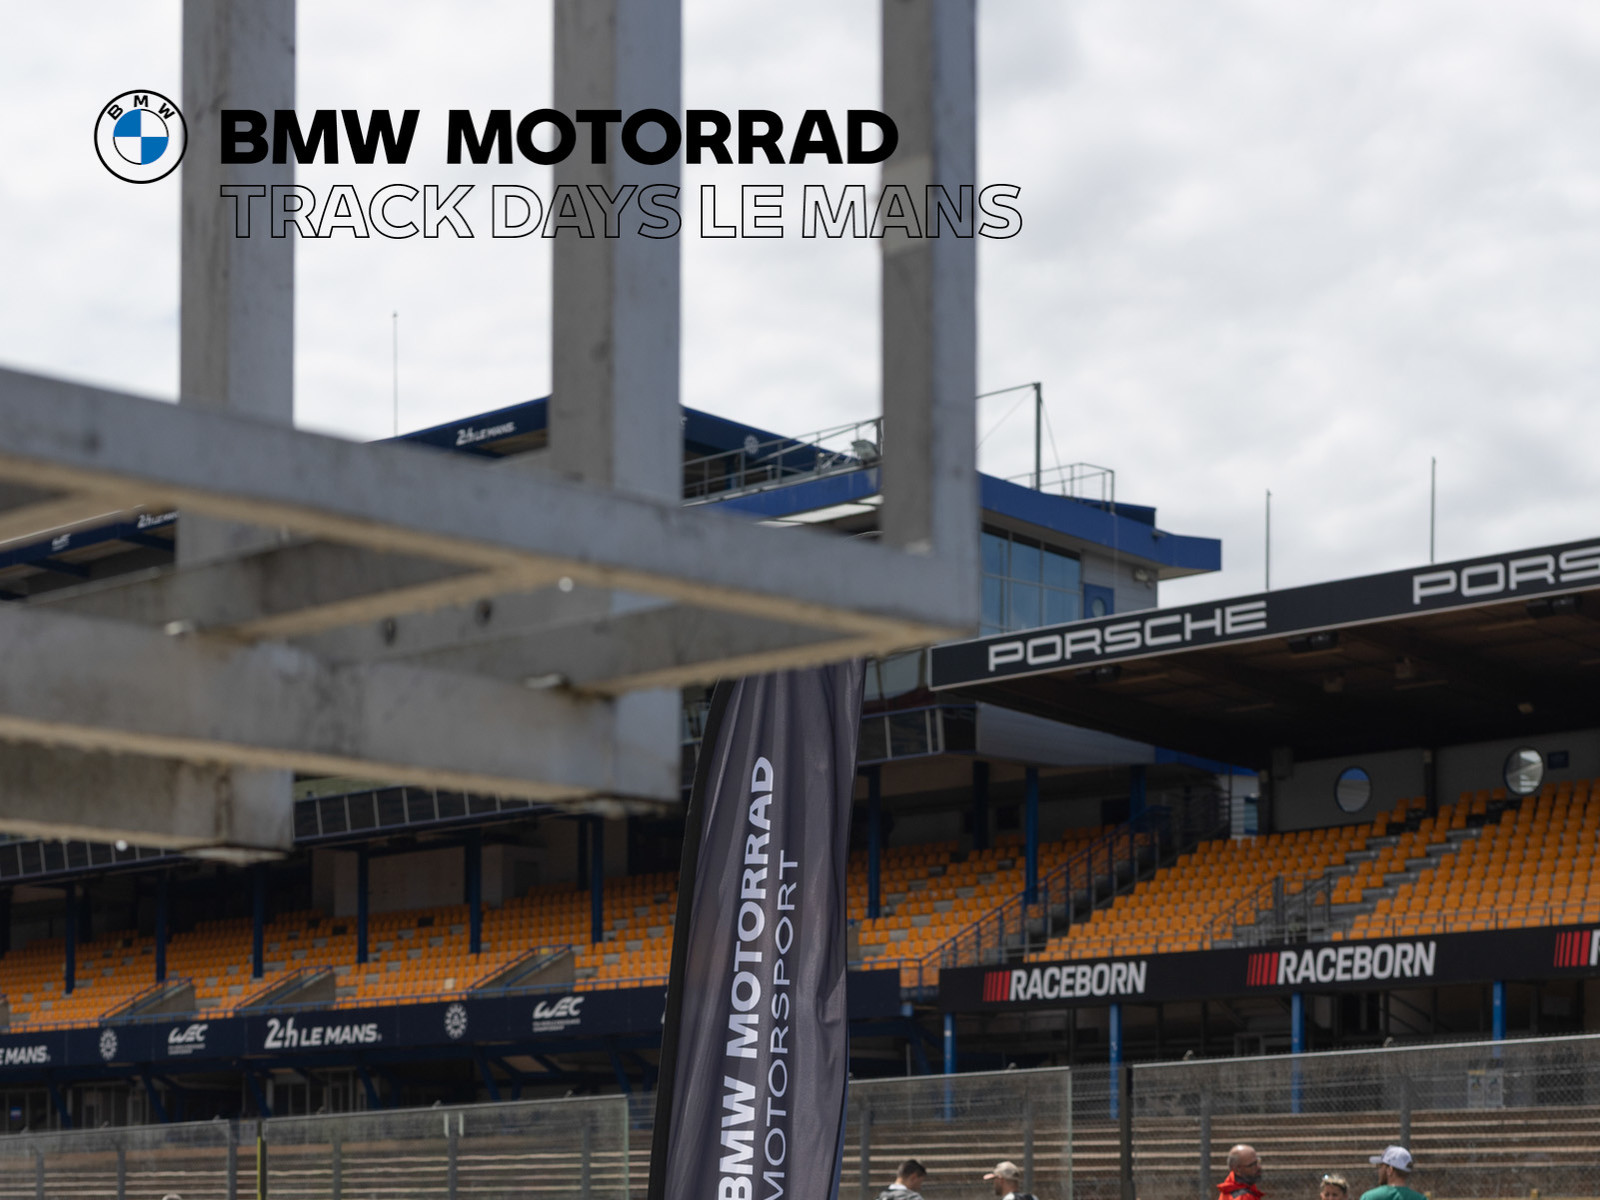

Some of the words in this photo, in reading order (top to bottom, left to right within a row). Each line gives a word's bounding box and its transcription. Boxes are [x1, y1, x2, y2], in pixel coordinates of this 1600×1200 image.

[1413, 545, 1600, 605] PORS
[988, 601, 1267, 671] PORSCHE
[725, 756, 774, 1059] MOTORRAD
[1008, 960, 1147, 1001] RACEBORN
[1276, 941, 1436, 985] RACEBORN
[300, 1027, 323, 1047] LE
[324, 1023, 378, 1045] MANS
